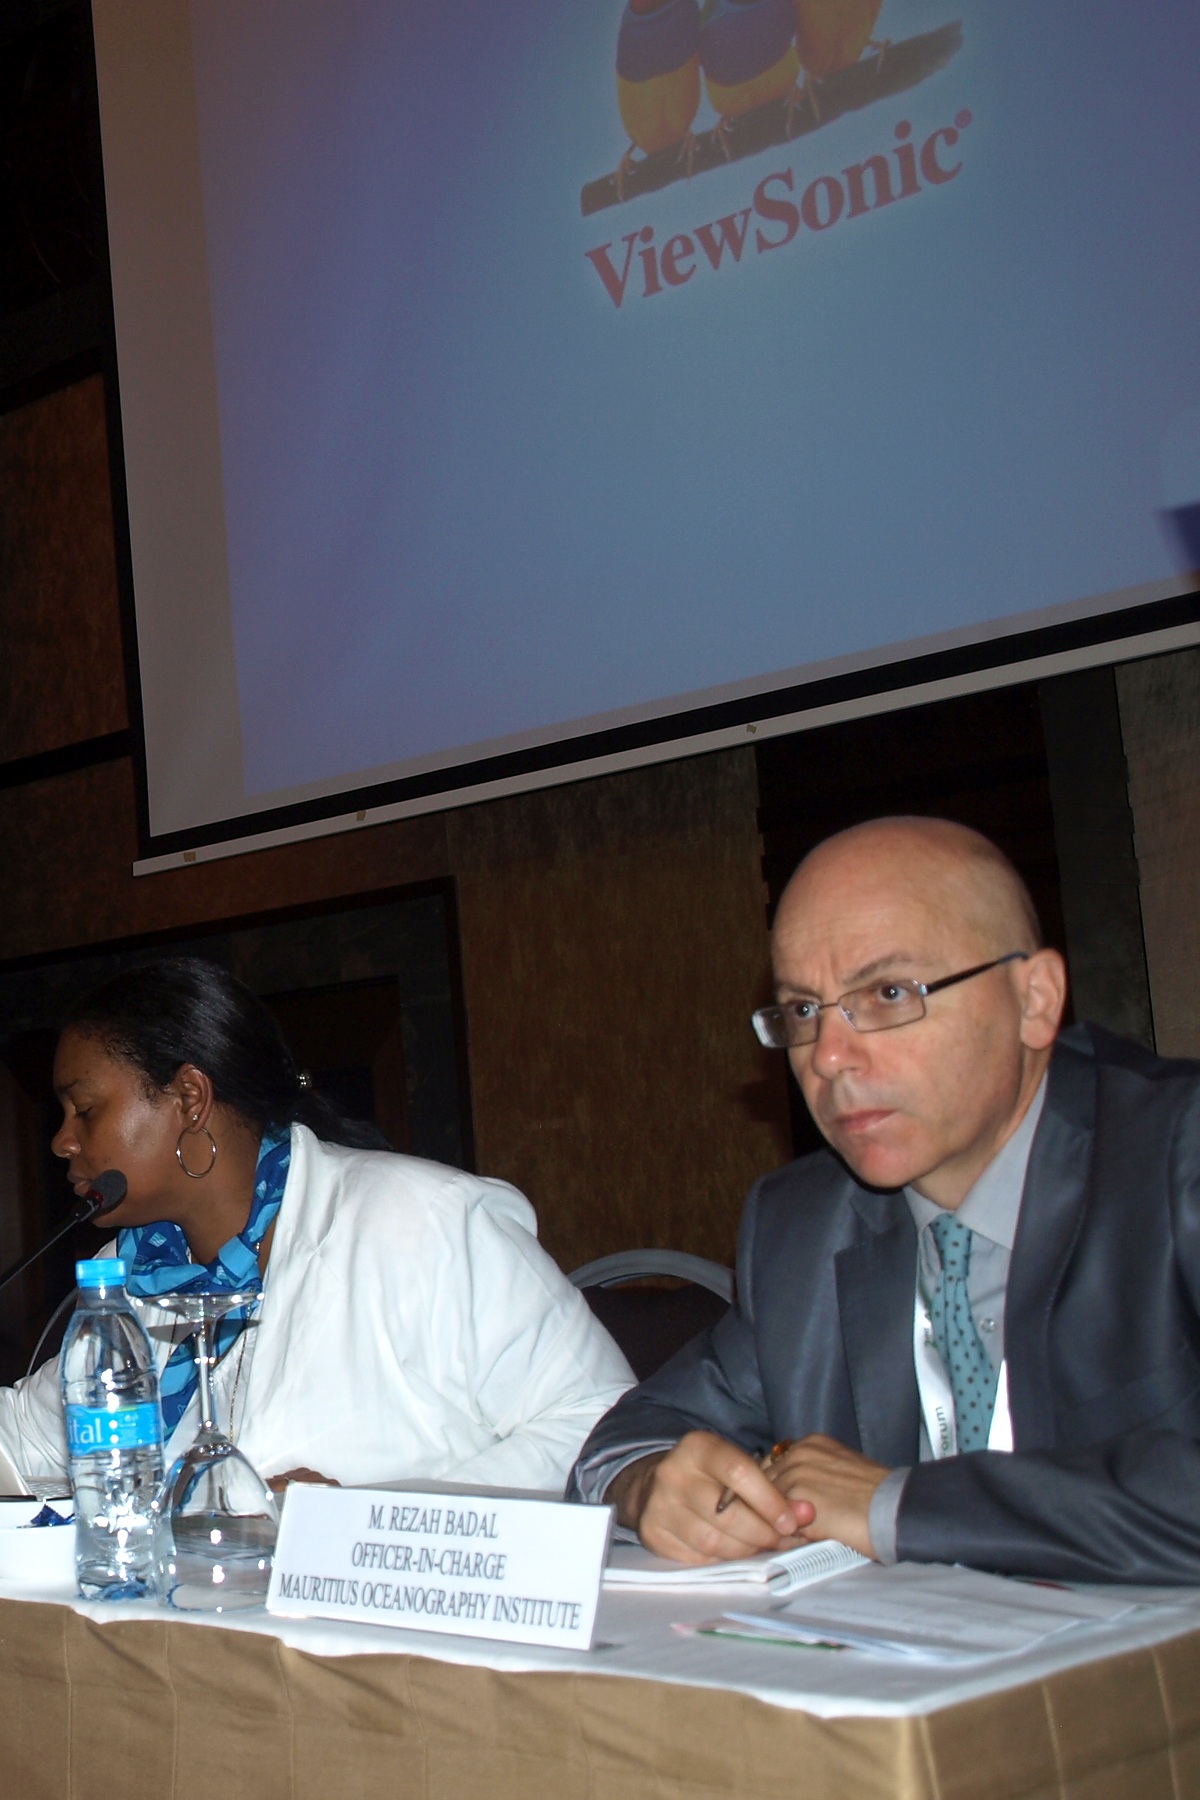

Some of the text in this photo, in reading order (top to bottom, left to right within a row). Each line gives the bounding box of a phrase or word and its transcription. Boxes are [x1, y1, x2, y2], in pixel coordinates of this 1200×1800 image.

[585, 119, 963, 309] ViewSonic
[69, 1417, 103, 1444] ital
[367, 1504, 499, 1539] M. REZAH BADAL
[351, 1542, 507, 1581] OFFICER-IN-CHARGE
[278, 1573, 582, 1630] MAURITIUS OCEANOGRAPHY INSTITUTE
